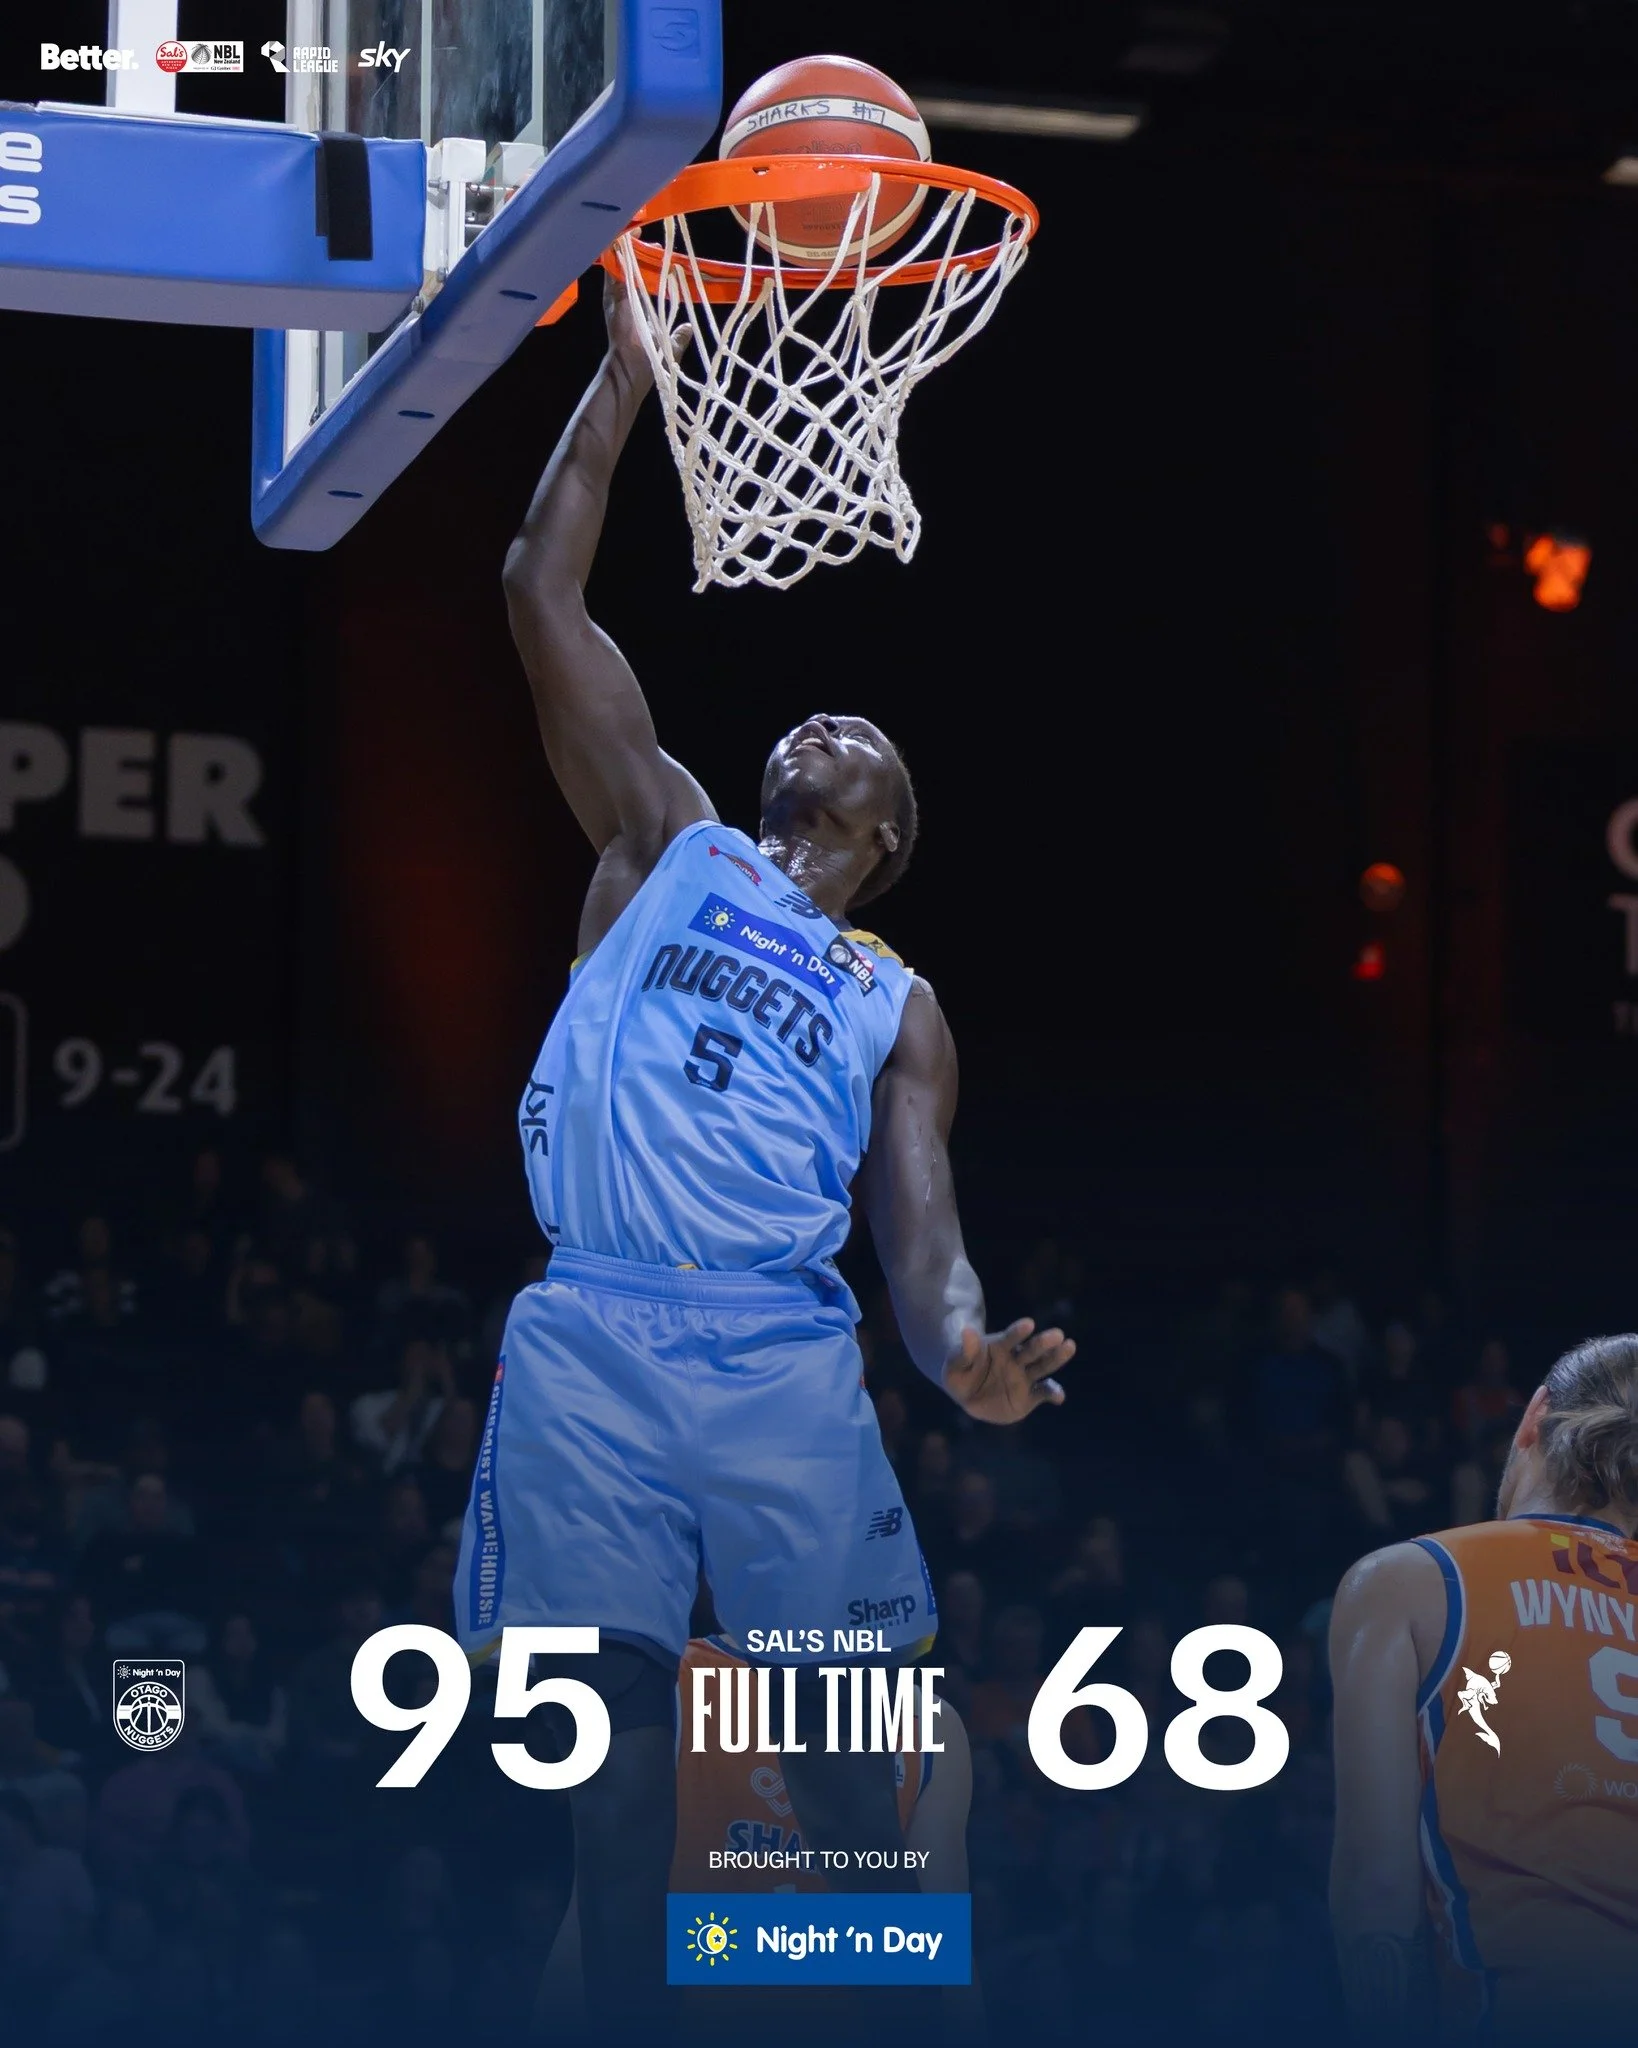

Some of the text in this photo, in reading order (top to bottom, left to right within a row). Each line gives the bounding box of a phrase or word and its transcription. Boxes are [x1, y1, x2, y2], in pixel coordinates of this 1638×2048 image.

[747, 100, 830, 132] SHARKS
[740, 925, 787, 956] Night
[806, 955, 835, 986] Day
[849, 959, 874, 988] NBL
[641, 943, 833, 1067] NUGGETS
[53, 1036, 238, 1116] 9-24
[683, 1023, 743, 1093] 5
[478, 1490, 499, 1626] WAREHOUSE
[847, 1594, 917, 1626] Sharp
[1511, 1579, 1636, 1641] WYNY
